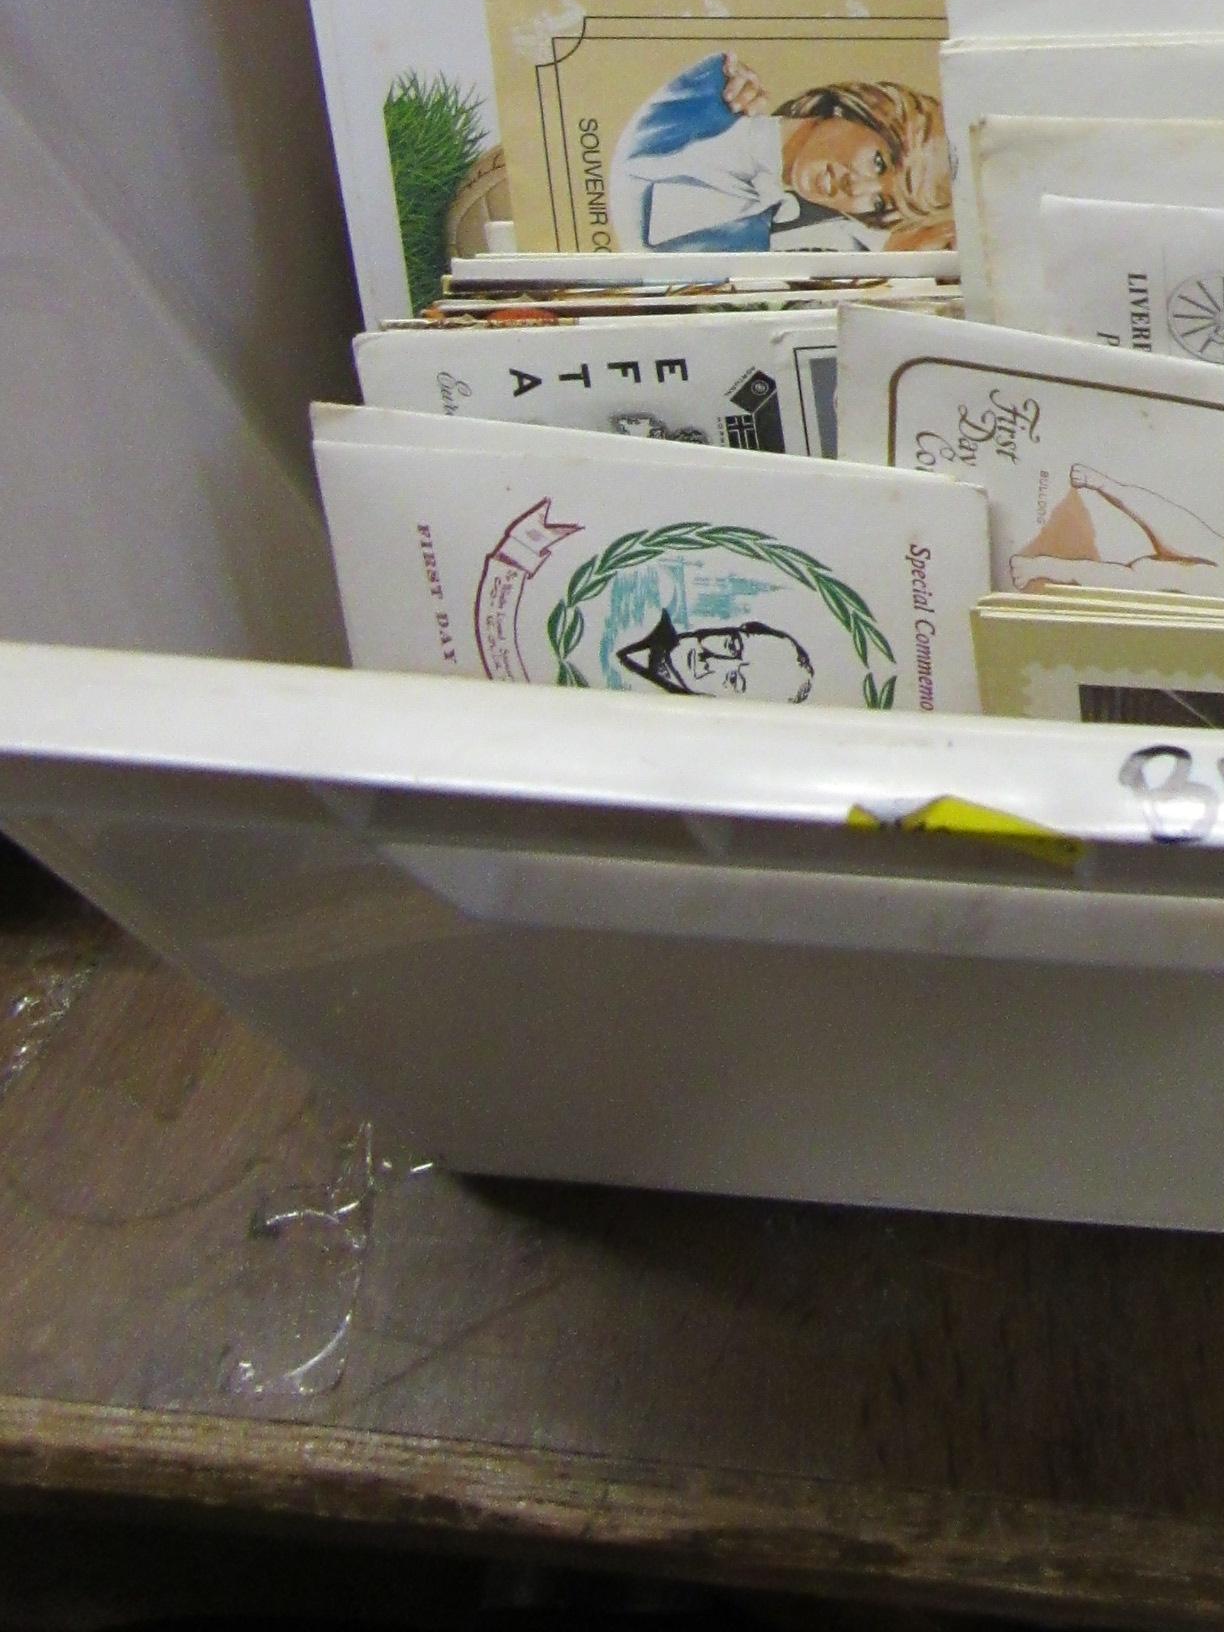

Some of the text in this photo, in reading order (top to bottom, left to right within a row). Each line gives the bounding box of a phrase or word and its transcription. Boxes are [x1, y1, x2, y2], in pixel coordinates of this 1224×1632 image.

[578, 117, 609, 225] SOUVENIR
[957, 403, 998, 468] Day
[989, 388, 1041, 465] First
[1037, 470, 1049, 524] BULLDOG
[417, 524, 457, 664] FIRST DAY
[905, 543, 937, 712] Special Commemo
